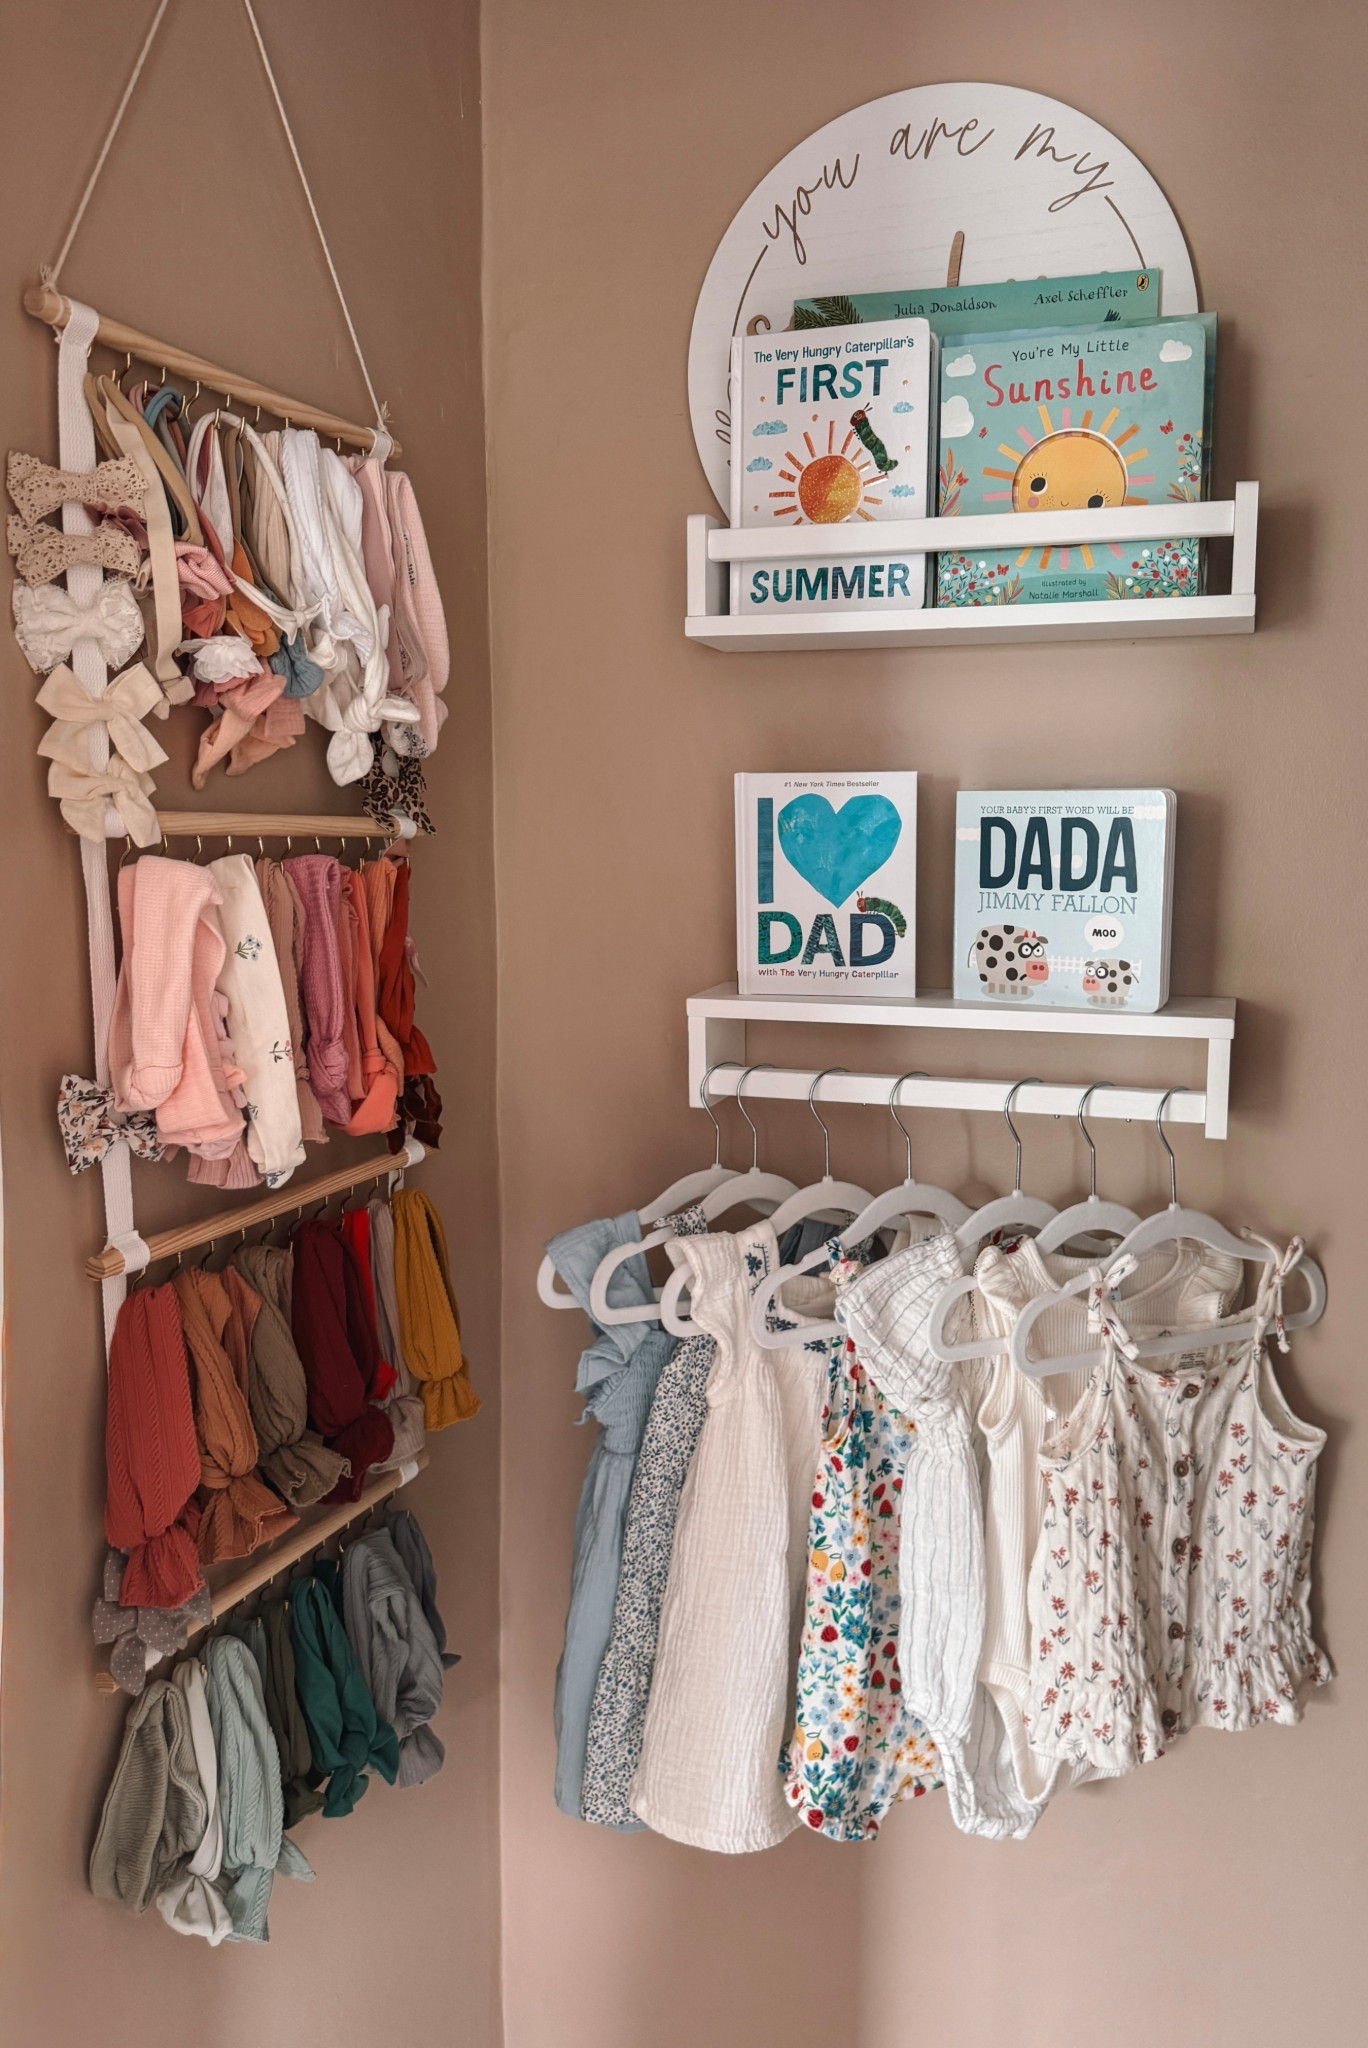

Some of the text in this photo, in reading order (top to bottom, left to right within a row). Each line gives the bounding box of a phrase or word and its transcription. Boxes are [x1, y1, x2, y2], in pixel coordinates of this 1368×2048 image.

[762, 117, 1114, 265] you are my
[1033, 285, 1128, 305] Axel Scheffler
[894, 299, 997, 318] Julia Donaldson
[754, 336, 914, 363] The Very Hungry Caterpillar's
[1012, 339, 1130, 362] You're My Little
[776, 358, 889, 405] FIRST
[983, 358, 1158, 408] Sunshine
[750, 563, 911, 604] SUMMER
[1029, 588, 1099, 600] Natalie Marshall
[1041, 578, 1087, 587] Illustrated by
[846, 780, 879, 788] Bestseller
[980, 805, 1135, 815] YOUR BABY'S FIRST WORD WILL BE
[757, 797, 774, 904] I
[979, 816, 1138, 894] DADA
[977, 892, 1138, 915] JIMMY FALLON
[757, 910, 896, 967] DAD
[1092, 928, 1117, 938] MOO
[758, 968, 899, 980] with The Very Hungry Caterpillar
